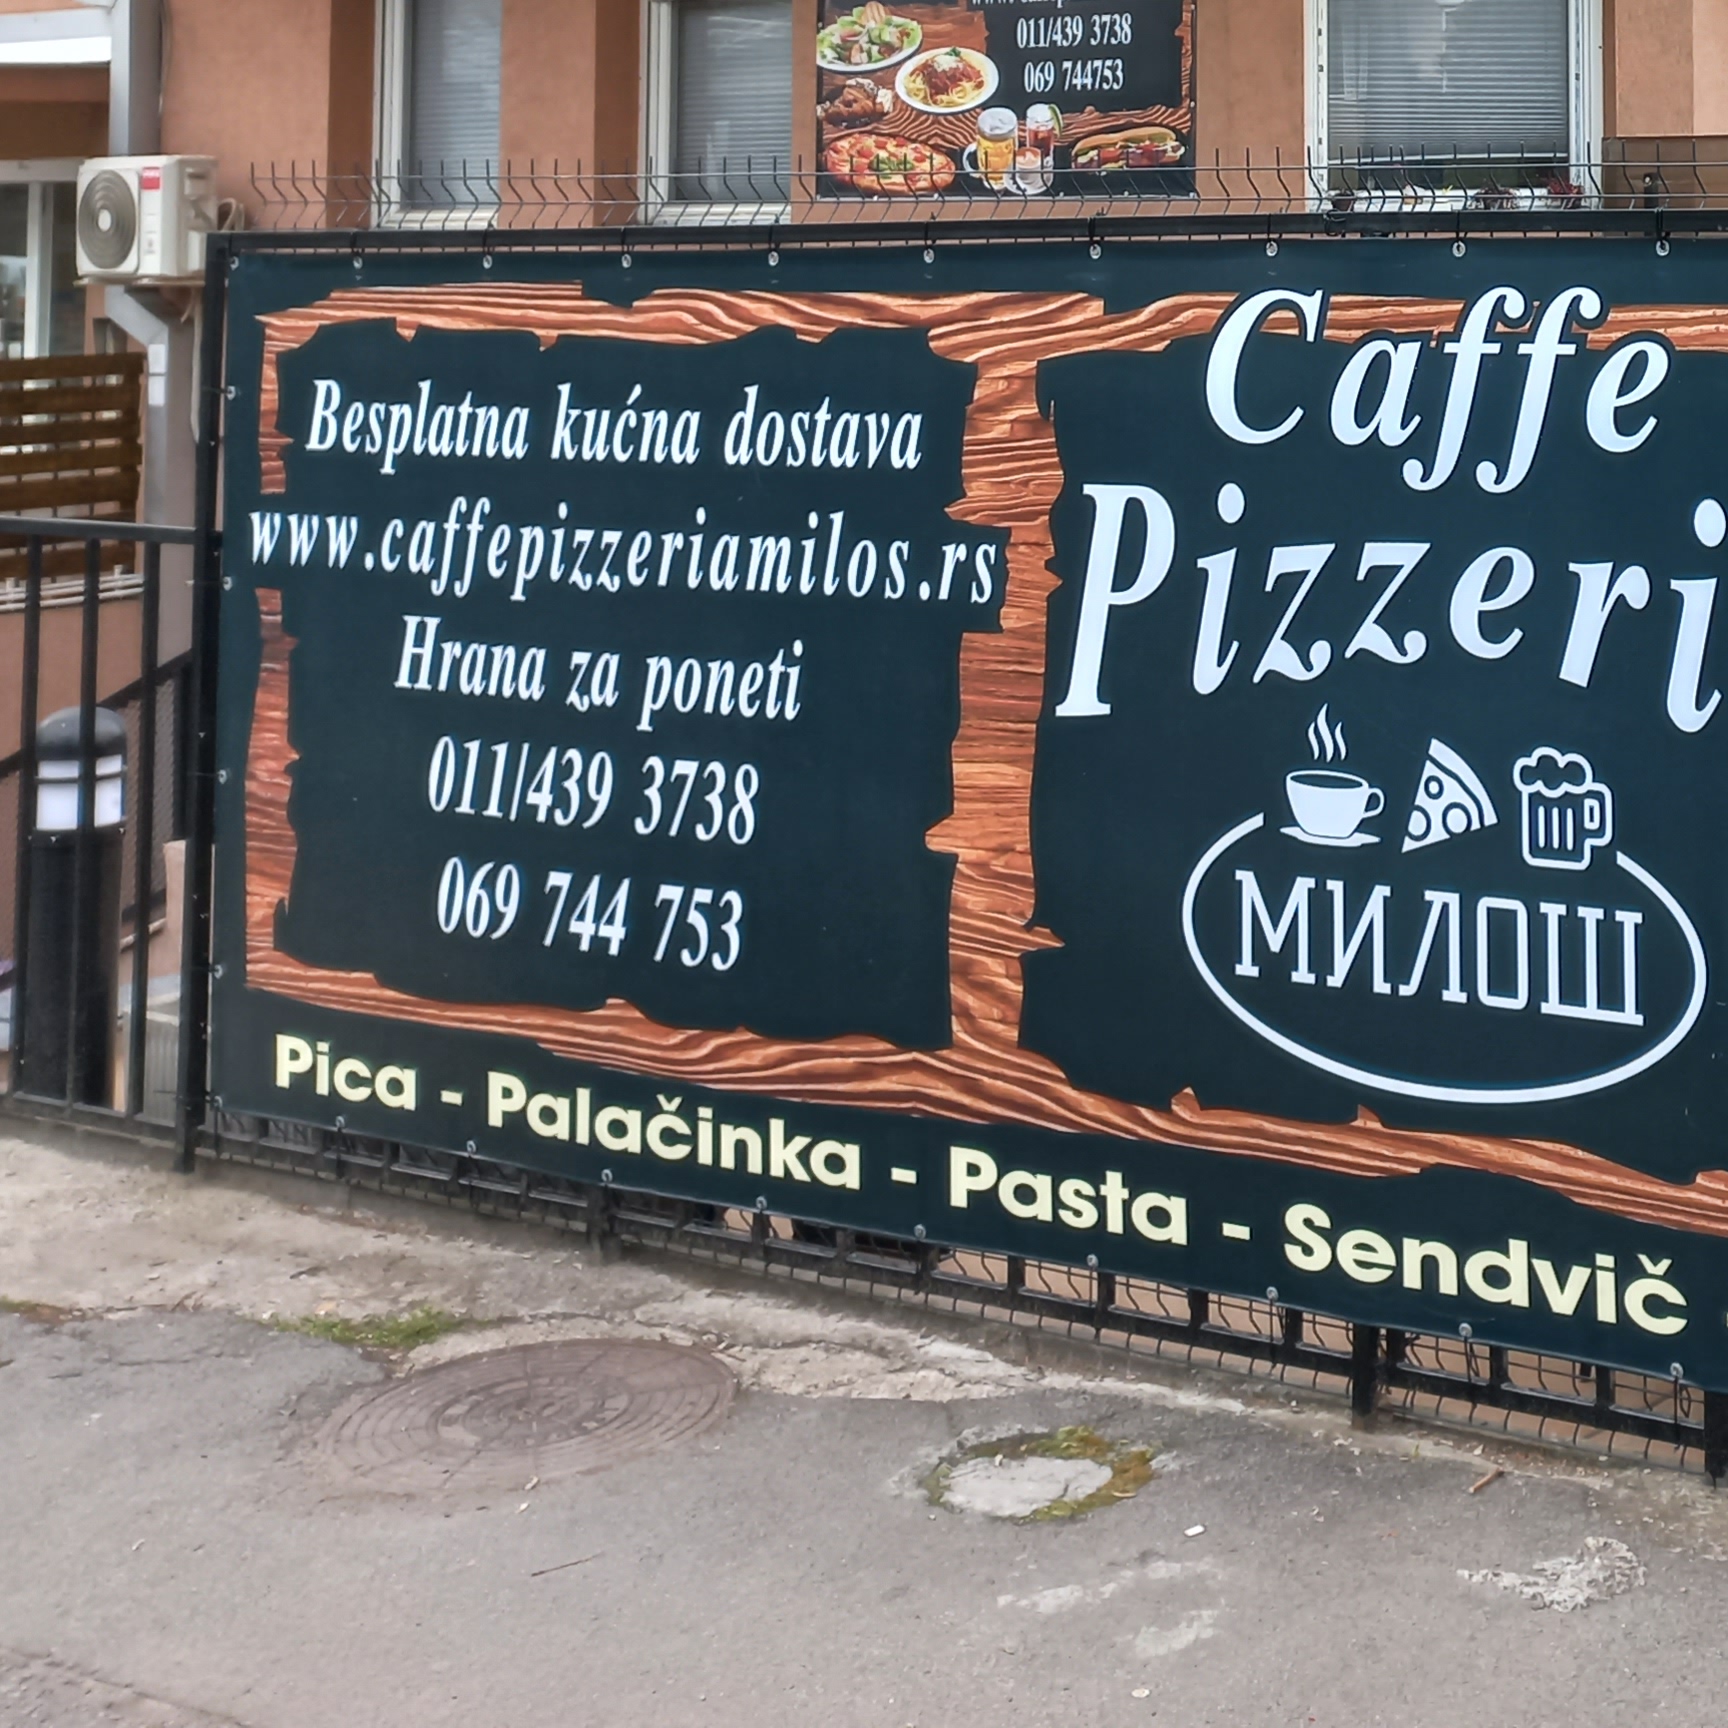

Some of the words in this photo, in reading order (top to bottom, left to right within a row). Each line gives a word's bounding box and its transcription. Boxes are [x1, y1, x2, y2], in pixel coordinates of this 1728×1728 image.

[1017, 16, 1082, 48] 011/439
[1091, 13, 1131, 45] 3738
[1025, 62, 1054, 92] 069
[1063, 59, 1123, 90] 744753
[306, 380, 529, 474] Besplatna
[551, 383, 700, 464] kućna
[725, 385, 921, 469] dostava
[1206, 287, 1668, 493] Caffe
[250, 497, 996, 603] www.caffepizzeriamilos.rs
[395, 616, 546, 700] Hrana
[566, 652, 619, 711] za
[637, 640, 802, 731] poneti
[429, 737, 612, 828] 011/439
[635, 756, 758, 844] 3738
[438, 857, 519, 939] 069
[544, 871, 629, 955] 744
[655, 885, 742, 970] 753
[1236, 870, 1643, 1025] МИЛОШ
[276, 1035, 416, 1110] Pica
[488, 1072, 859, 1189] Palačinka
[950, 1146, 1187, 1245] Pasta
[1285, 1204, 1687, 1334] Sendvič
